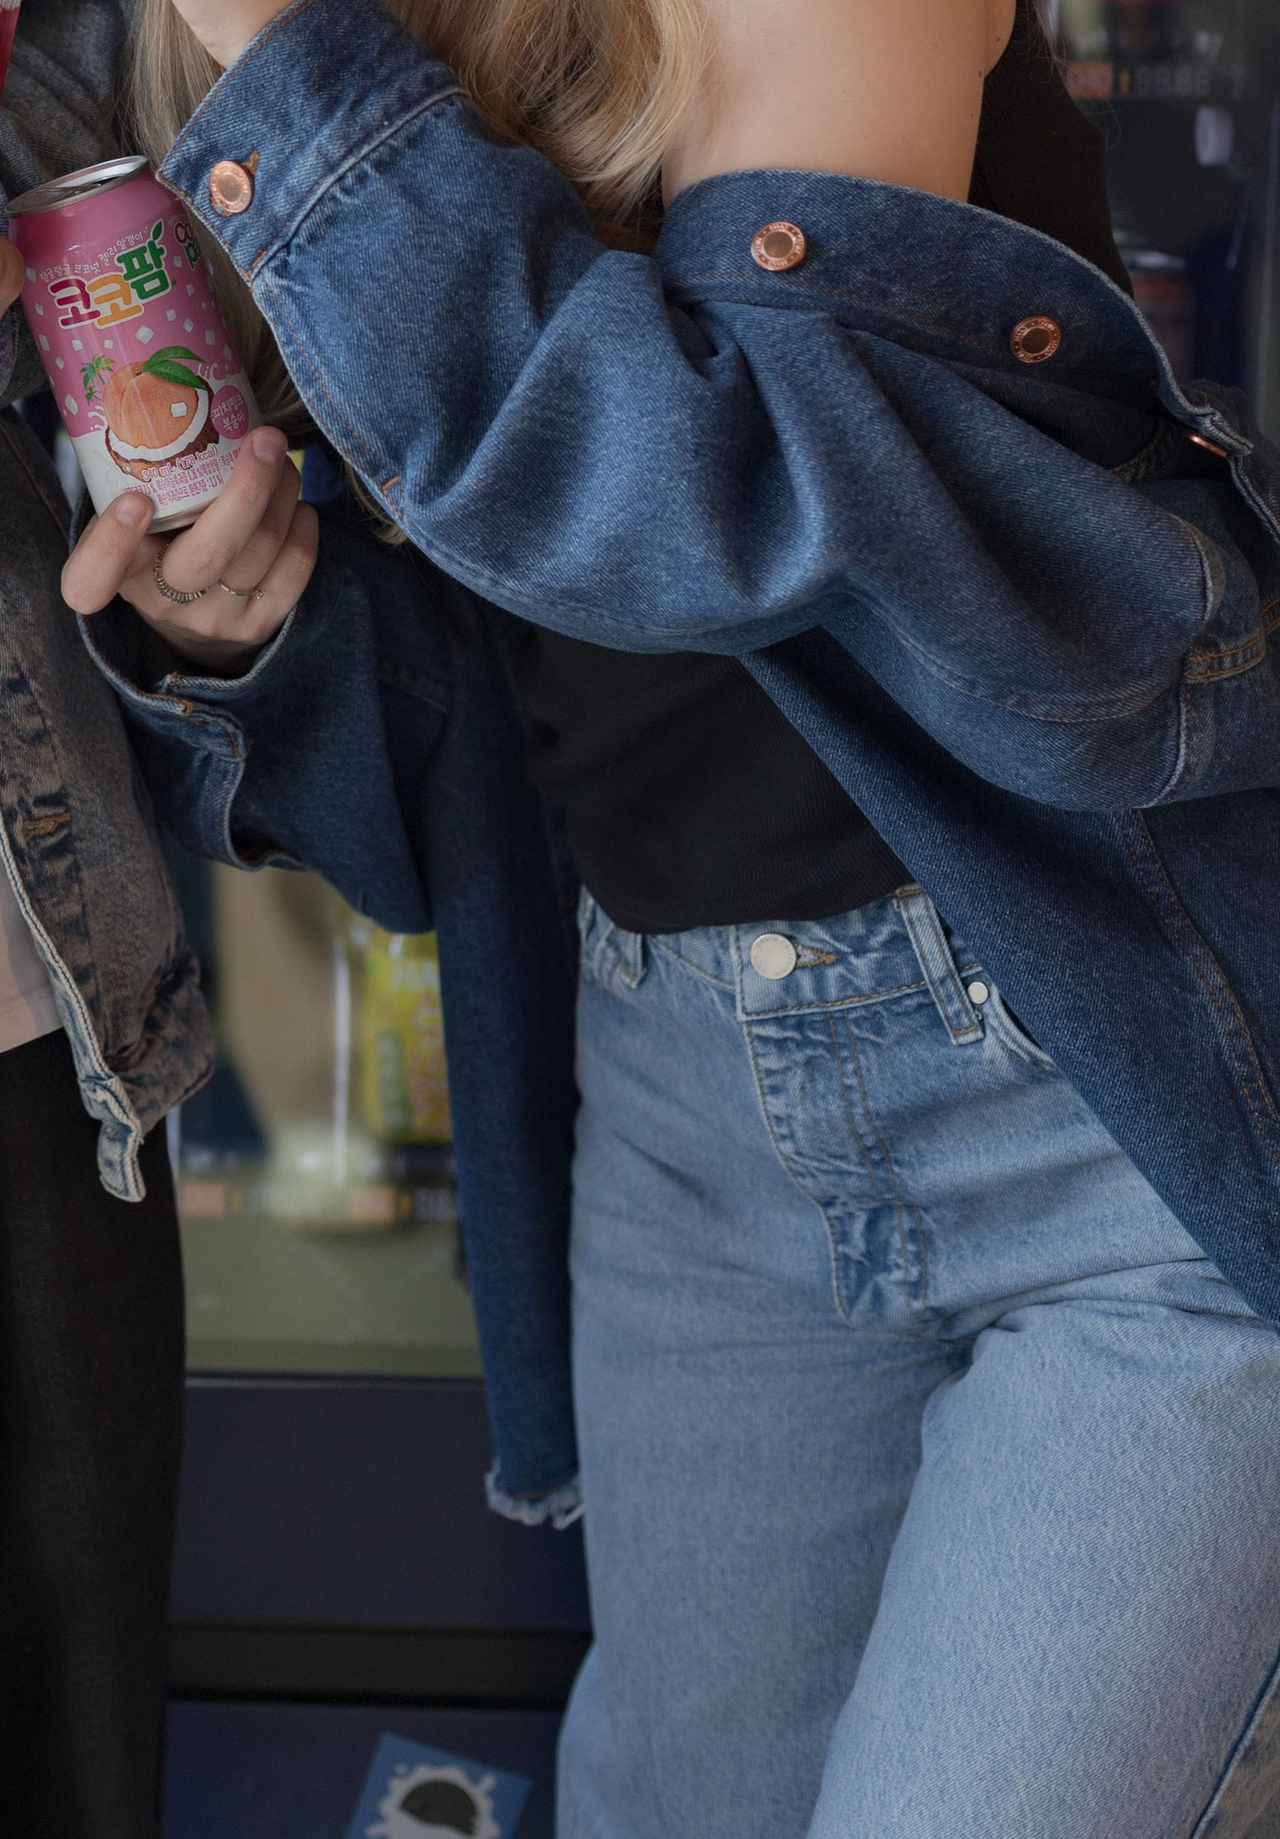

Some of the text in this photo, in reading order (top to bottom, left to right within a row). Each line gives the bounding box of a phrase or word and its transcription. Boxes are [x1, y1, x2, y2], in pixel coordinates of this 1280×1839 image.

[74, 261, 101, 275] 코코넛
[98, 245, 118, 267] 젤리
[116, 231, 144, 250] 알갱이
[49, 240, 166, 327] 코코팜
[223, 411, 246, 431] 복숭아
[142, 466, 159, 481] 340
[196, 443, 219, 464] kcal)
